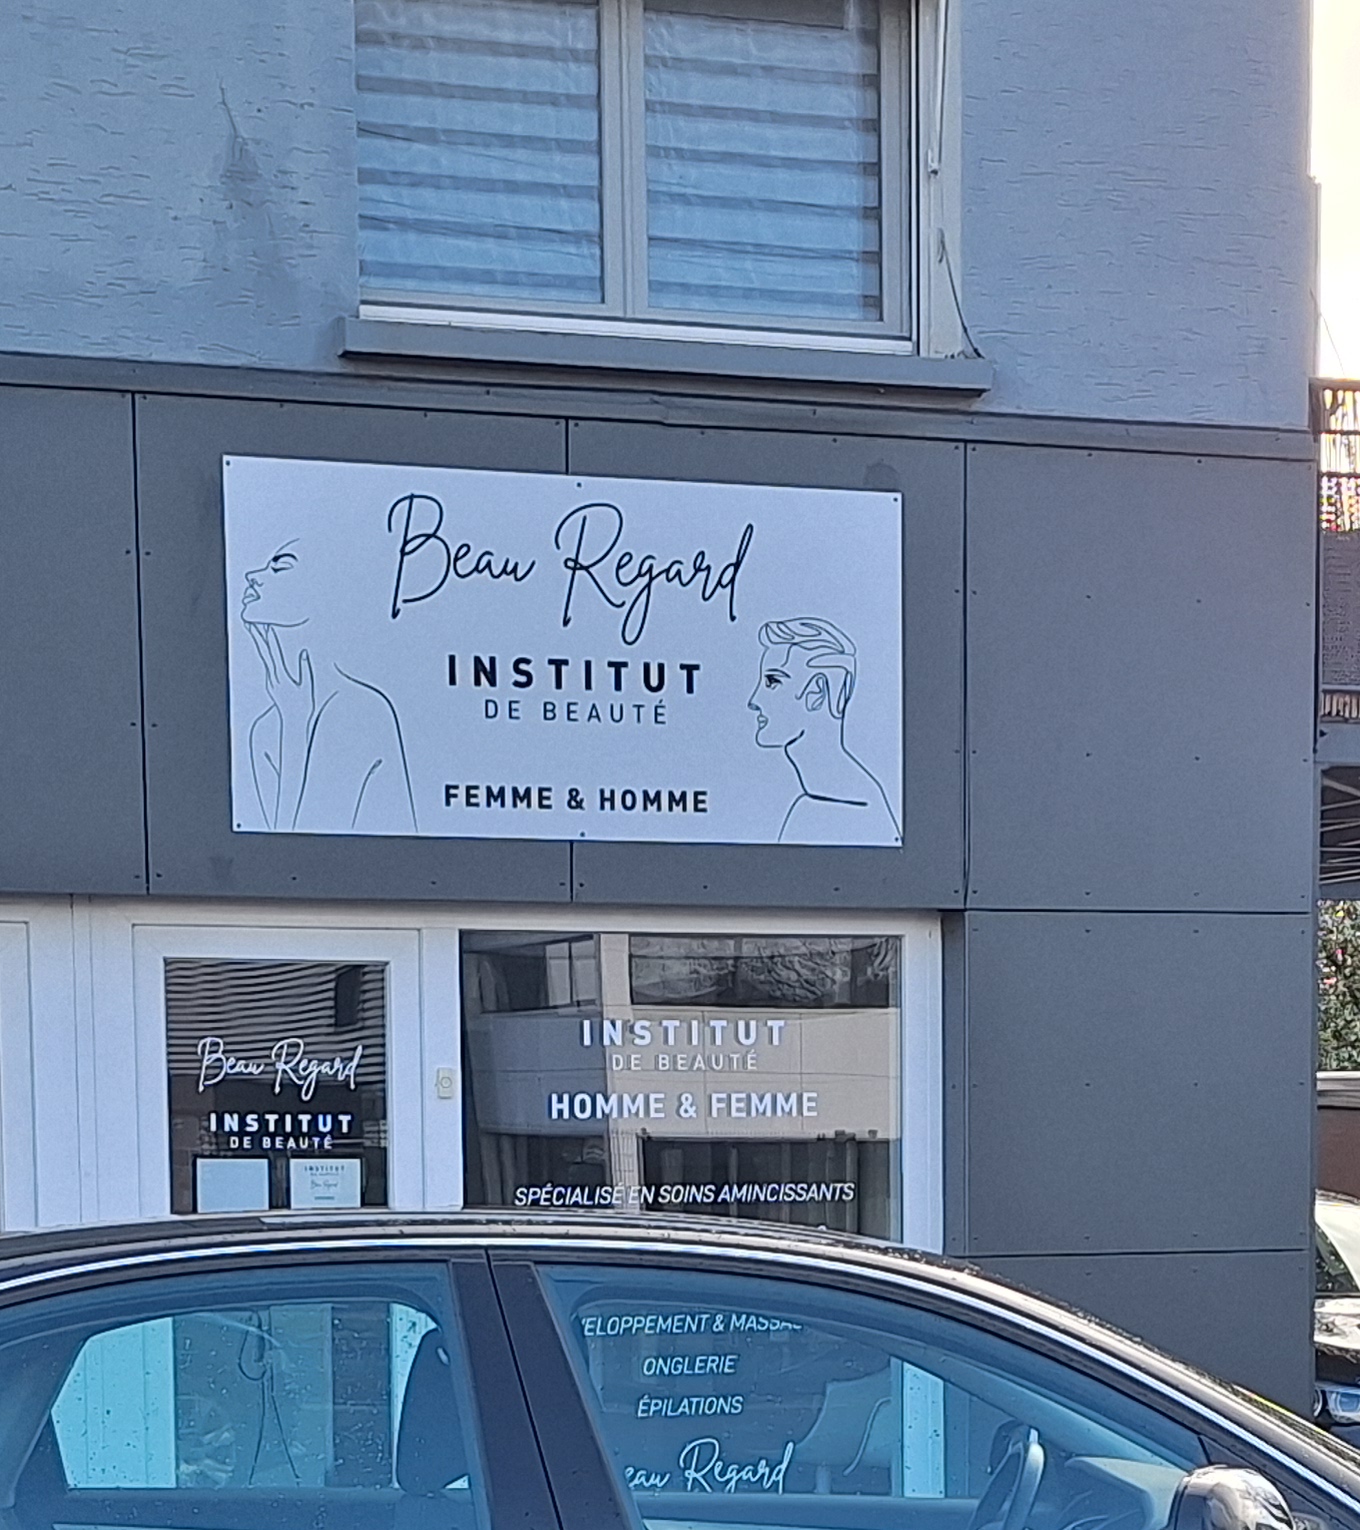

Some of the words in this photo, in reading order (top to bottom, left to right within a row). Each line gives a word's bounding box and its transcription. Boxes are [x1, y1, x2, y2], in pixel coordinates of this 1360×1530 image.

[387, 493, 536, 620] Beau
[554, 502, 753, 646] Regard
[447, 654, 701, 695] INSTITUT
[484, 699, 521, 721] DE
[543, 699, 667, 725] BEAUTÉ
[444, 784, 553, 810] FEMME
[566, 787, 586, 811] &
[599, 788, 708, 814] HOMME
[581, 1018, 786, 1047] INSTITUT
[197, 1036, 265, 1094] Beau
[271, 1037, 363, 1101] Regard
[611, 1054, 642, 1071] DE
[657, 1050, 758, 1071] BEAUTÉ
[550, 1092, 666, 1120] HOMME
[679, 1092, 698, 1119] &
[711, 1091, 819, 1118] FEMME
[209, 1113, 352, 1134] INSTITUT
[229, 1136, 252, 1149] DE
[262, 1134, 333, 1150] BEAUTÉ
[514, 1182, 624, 1207] SPÉCIALISÉ
[627, 1185, 655, 1206] EN
[657, 1184, 716, 1204] SOINS
[717, 1182, 856, 1204] AMINCISSANTS
[581, 1313, 711, 1337] ELOPPEMENT
[712, 1314, 726, 1333] &
[642, 1354, 739, 1376] ONGLERIE
[636, 1394, 744, 1418] ÉPILATIONS
